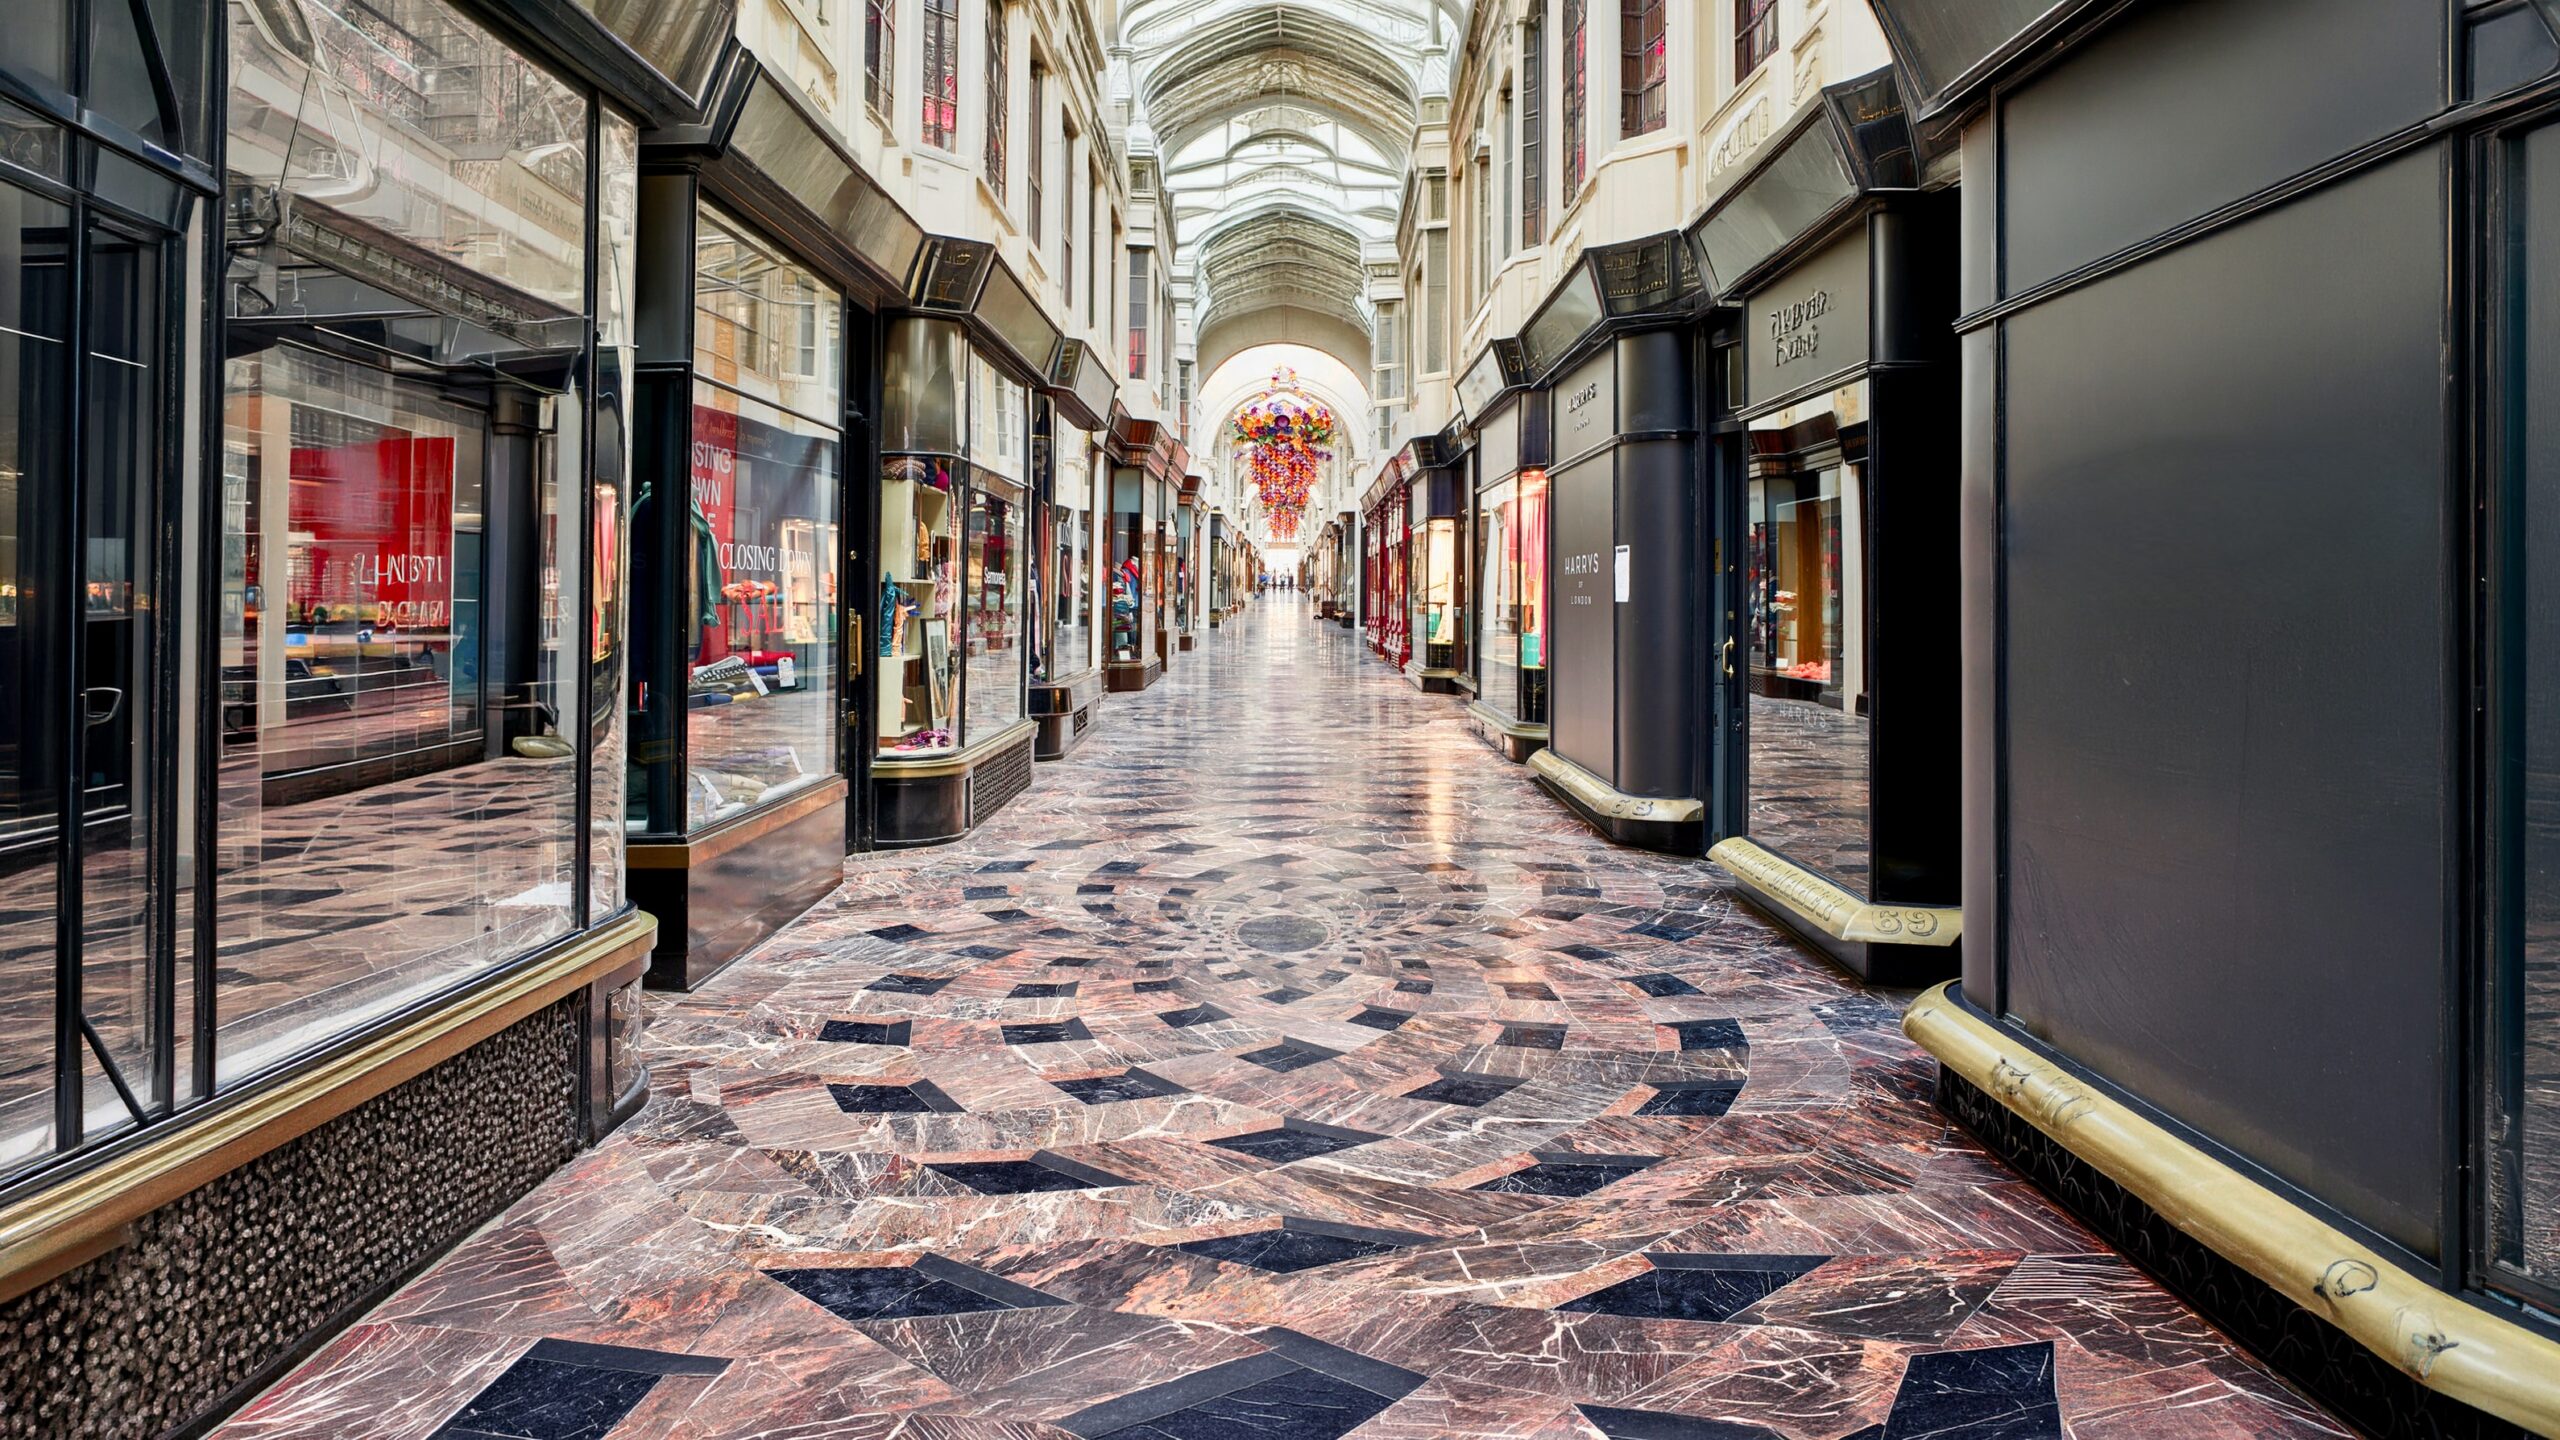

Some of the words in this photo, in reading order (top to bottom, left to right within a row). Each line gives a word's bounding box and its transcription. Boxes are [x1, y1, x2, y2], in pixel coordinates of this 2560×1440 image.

[692, 442, 732, 474] SING
[720, 543, 775, 572] CLOSING
[779, 548, 813, 573] DOWN
[1564, 552, 1599, 575] HARRYS
[1570, 595, 1592, 605] LONDON
